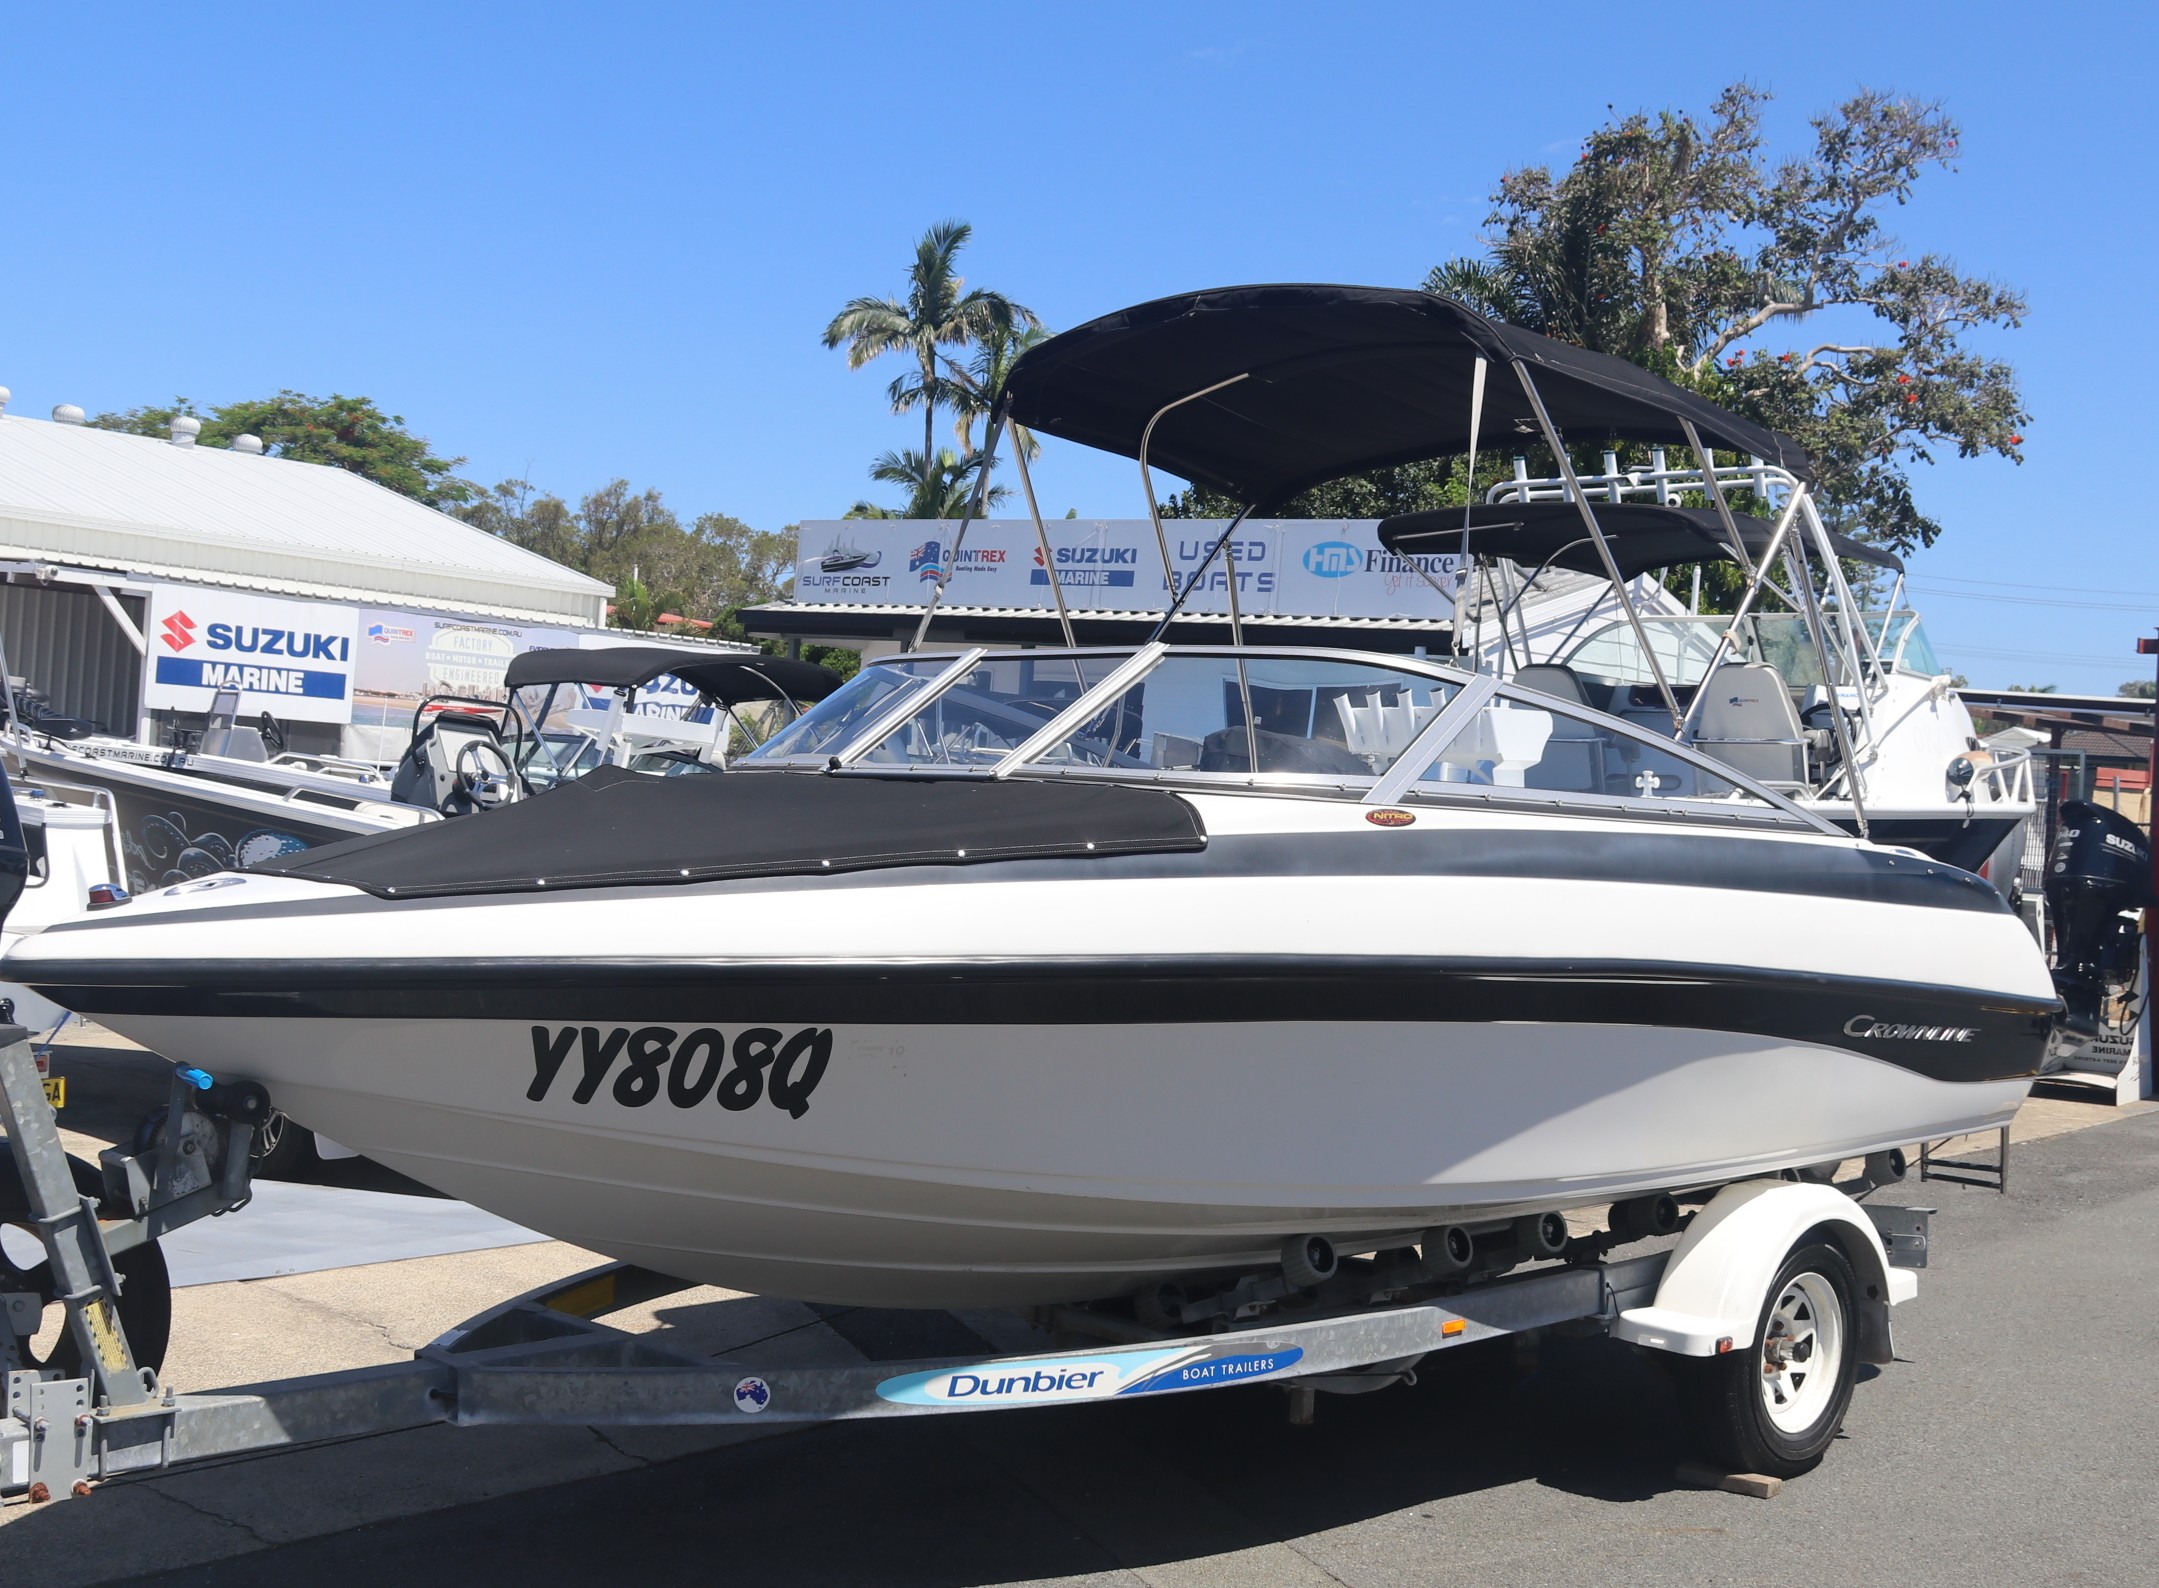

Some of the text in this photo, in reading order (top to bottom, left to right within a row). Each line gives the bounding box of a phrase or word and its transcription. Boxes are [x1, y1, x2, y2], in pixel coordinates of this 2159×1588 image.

[942, 549, 1006, 563] QUINTREX
[1056, 547, 1137, 564] SUZUKI
[1179, 540, 1266, 562] USED
[955, 565, 973, 573] Boating
[1364, 549, 1454, 574] Finance
[802, 576, 891, 586] SURFCOAST
[1055, 570, 1110, 585] MARINE
[1163, 571, 1275, 592] BOATS
[434, 621, 523, 638] SURFCOASTMARINE.COM.AU
[206, 622, 350, 662] SUZUKI
[453, 635, 493, 652] FACTORY
[425, 651, 445, 661] BOAT
[452, 653, 477, 665] MOTOR
[201, 662, 305, 694] MARINE
[443, 666, 500, 685] ENGINEERED
[1373, 811, 1414, 820] NITRO
[1843, 1014, 1981, 1043] CROWNLINE
[526, 1025, 833, 1120] YY808Q
[1182, 1358, 1274, 1380] BOAT TRAILERS
[947, 1368, 1104, 1398] Dunbier
